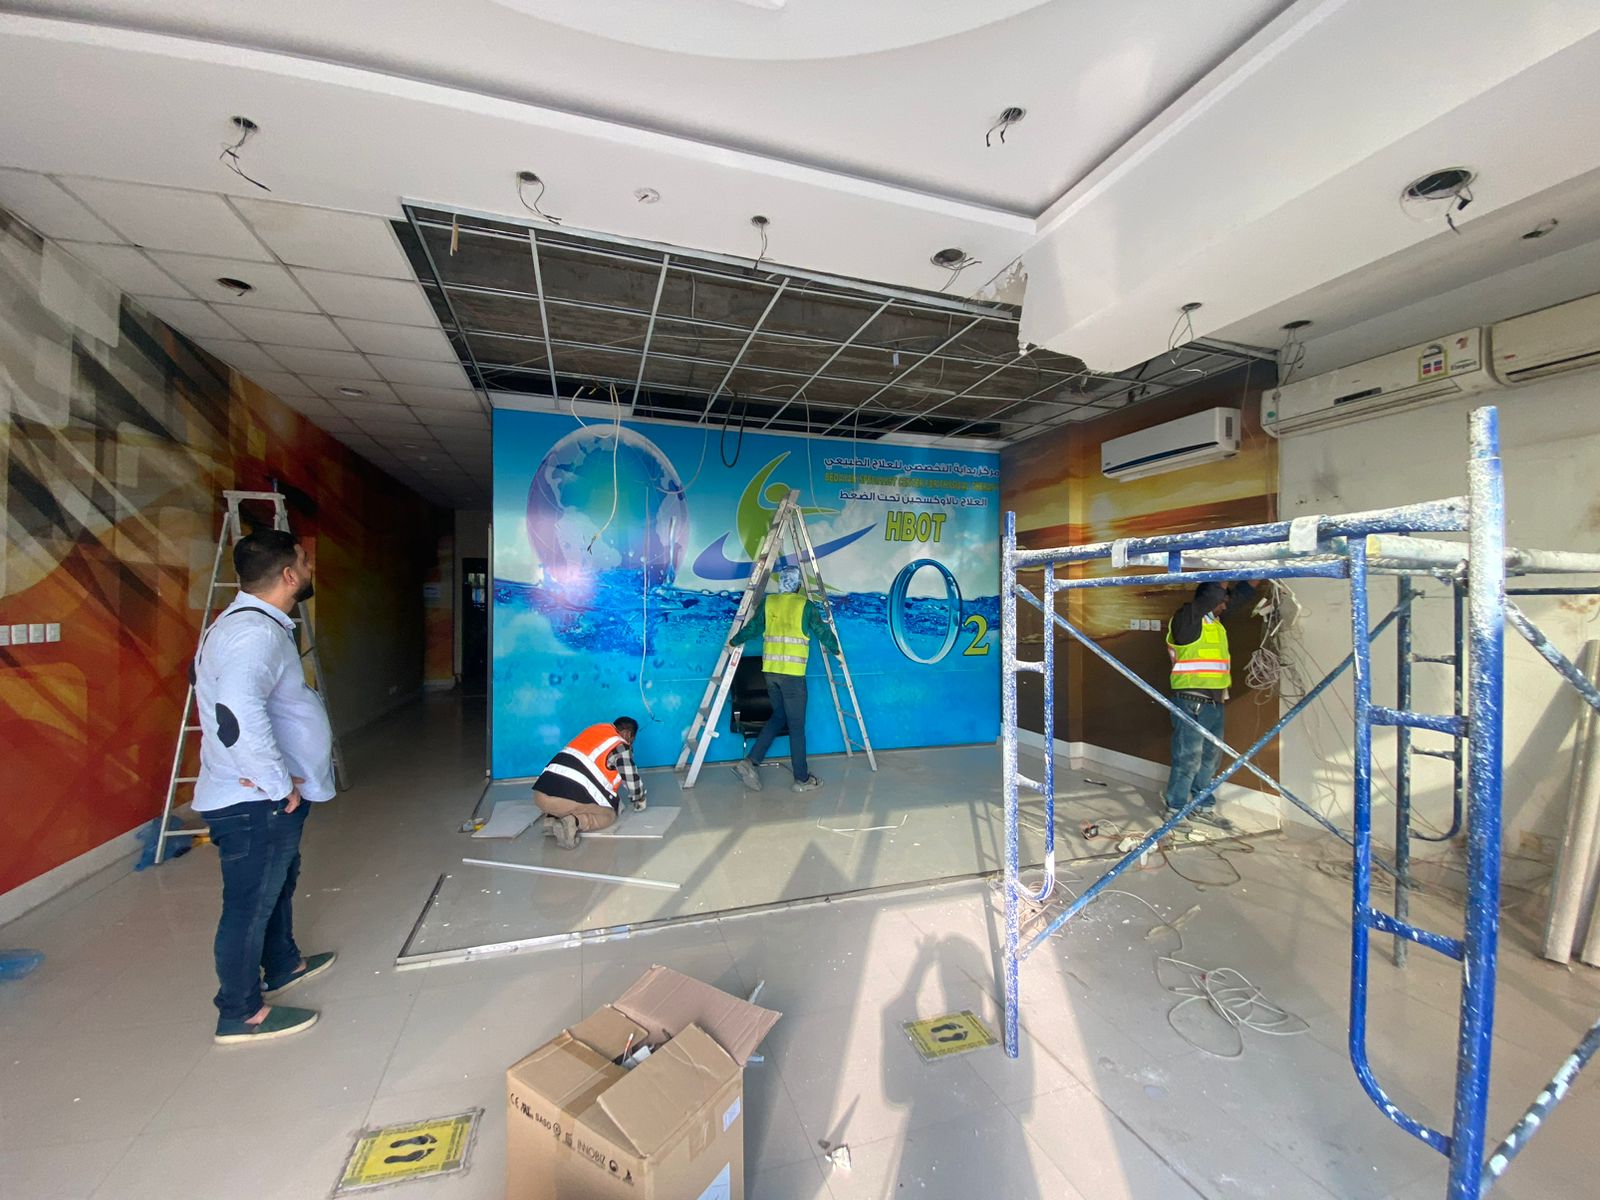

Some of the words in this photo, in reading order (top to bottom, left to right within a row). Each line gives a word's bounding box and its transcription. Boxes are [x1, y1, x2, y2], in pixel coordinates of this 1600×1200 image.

[823, 456, 871, 470] الطبيعي
[871, 458, 903, 471] للعلاج
[904, 462, 952, 475] التخصصي
[953, 462, 978, 476] بداية
[977, 464, 1000, 478] مركز
[839, 490, 875, 501] الضغط
[877, 492, 900, 502] تحت
[960, 497, 988, 507] العلاج
[885, 511, 947, 542] HBOT
